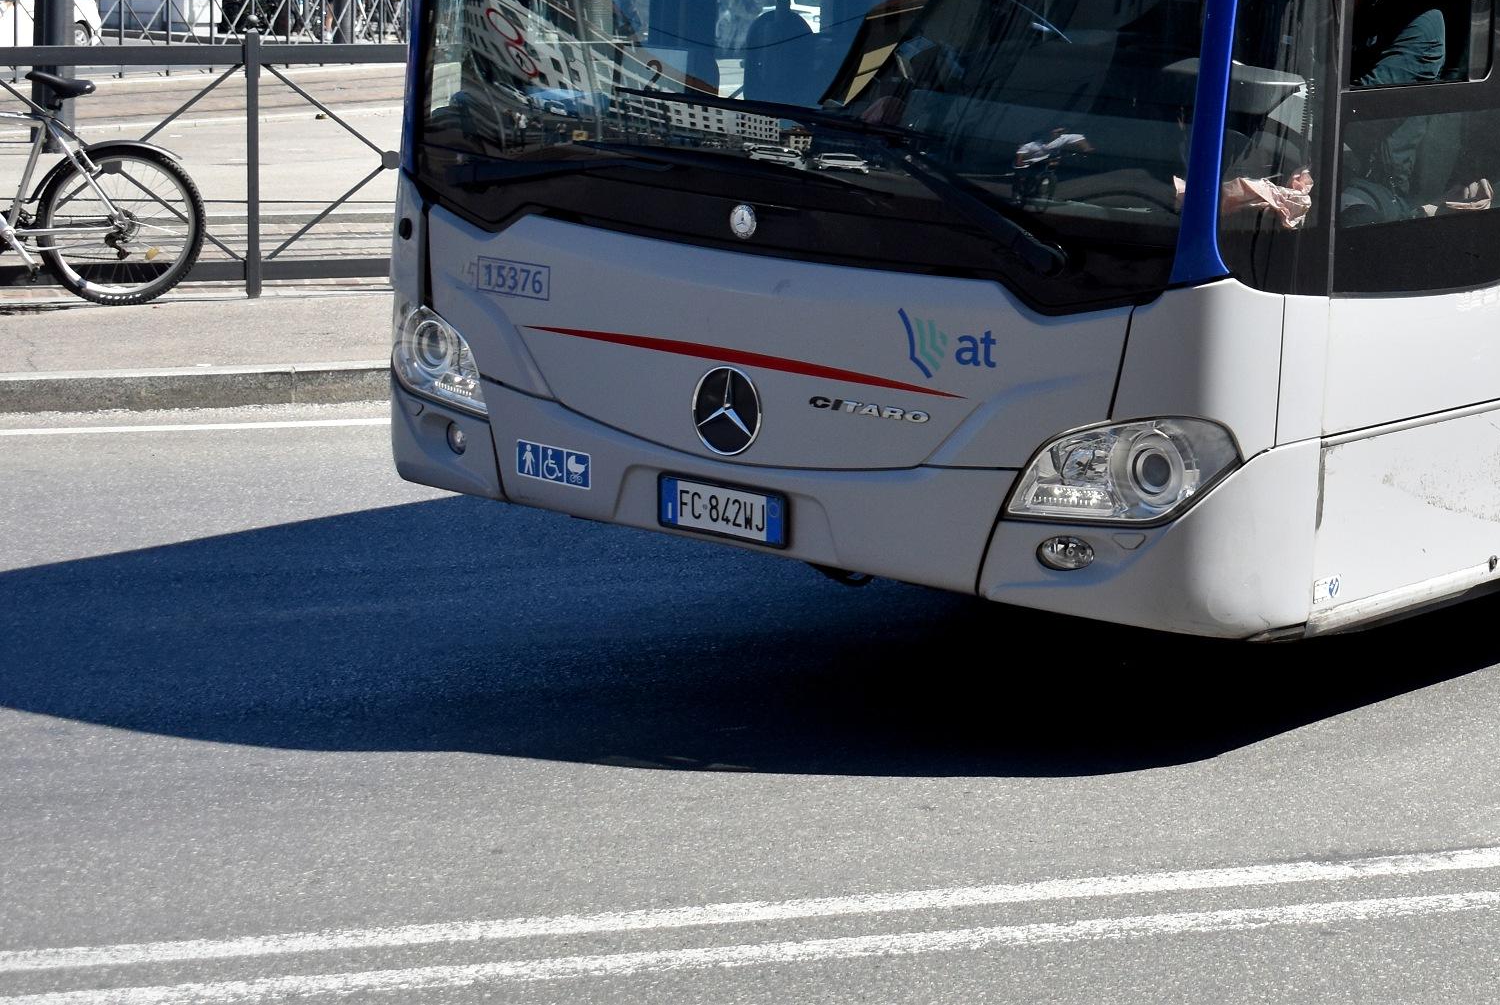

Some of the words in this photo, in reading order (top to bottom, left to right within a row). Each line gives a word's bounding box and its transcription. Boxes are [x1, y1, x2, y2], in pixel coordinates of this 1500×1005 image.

[484, 263, 543, 294] 15376
[955, 329, 997, 369] at
[808, 395, 931, 424] CITARO
[679, 489, 702, 520] FC
[708, 494, 766, 532] 842WJ
